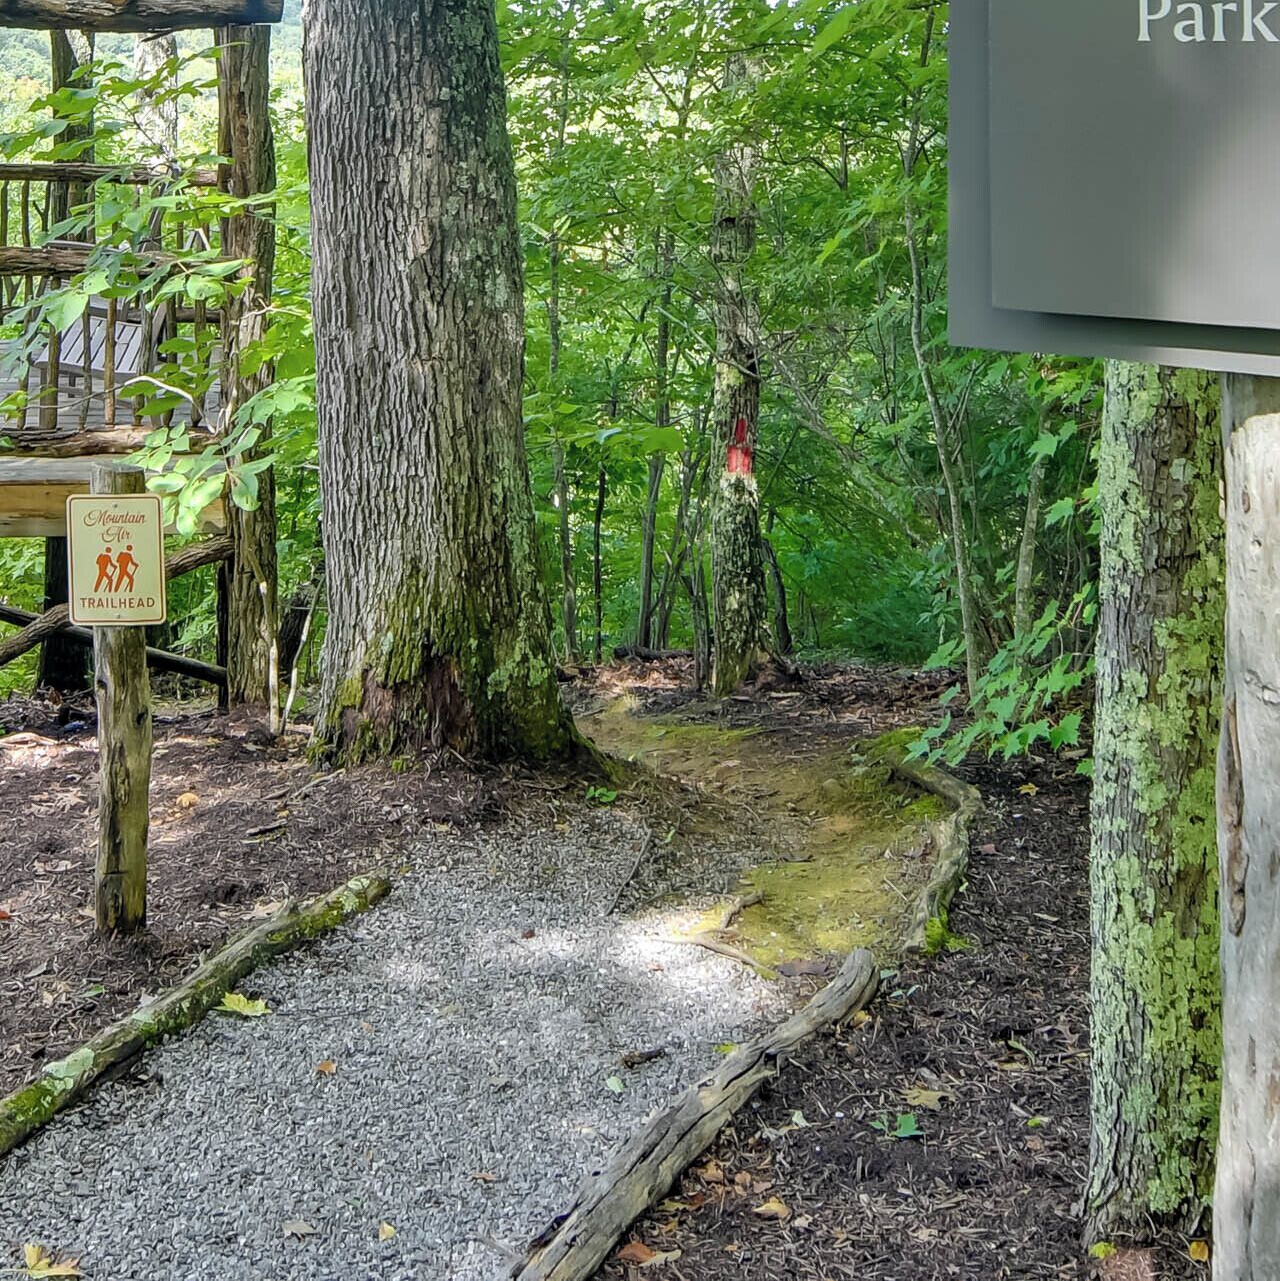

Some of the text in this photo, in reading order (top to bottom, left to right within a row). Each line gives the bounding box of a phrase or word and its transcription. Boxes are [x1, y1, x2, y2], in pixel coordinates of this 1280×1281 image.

[83, 509, 146, 527] Mountain
[101, 526, 131, 543] Air
[80, 597, 155, 609] TRAILHEAD
